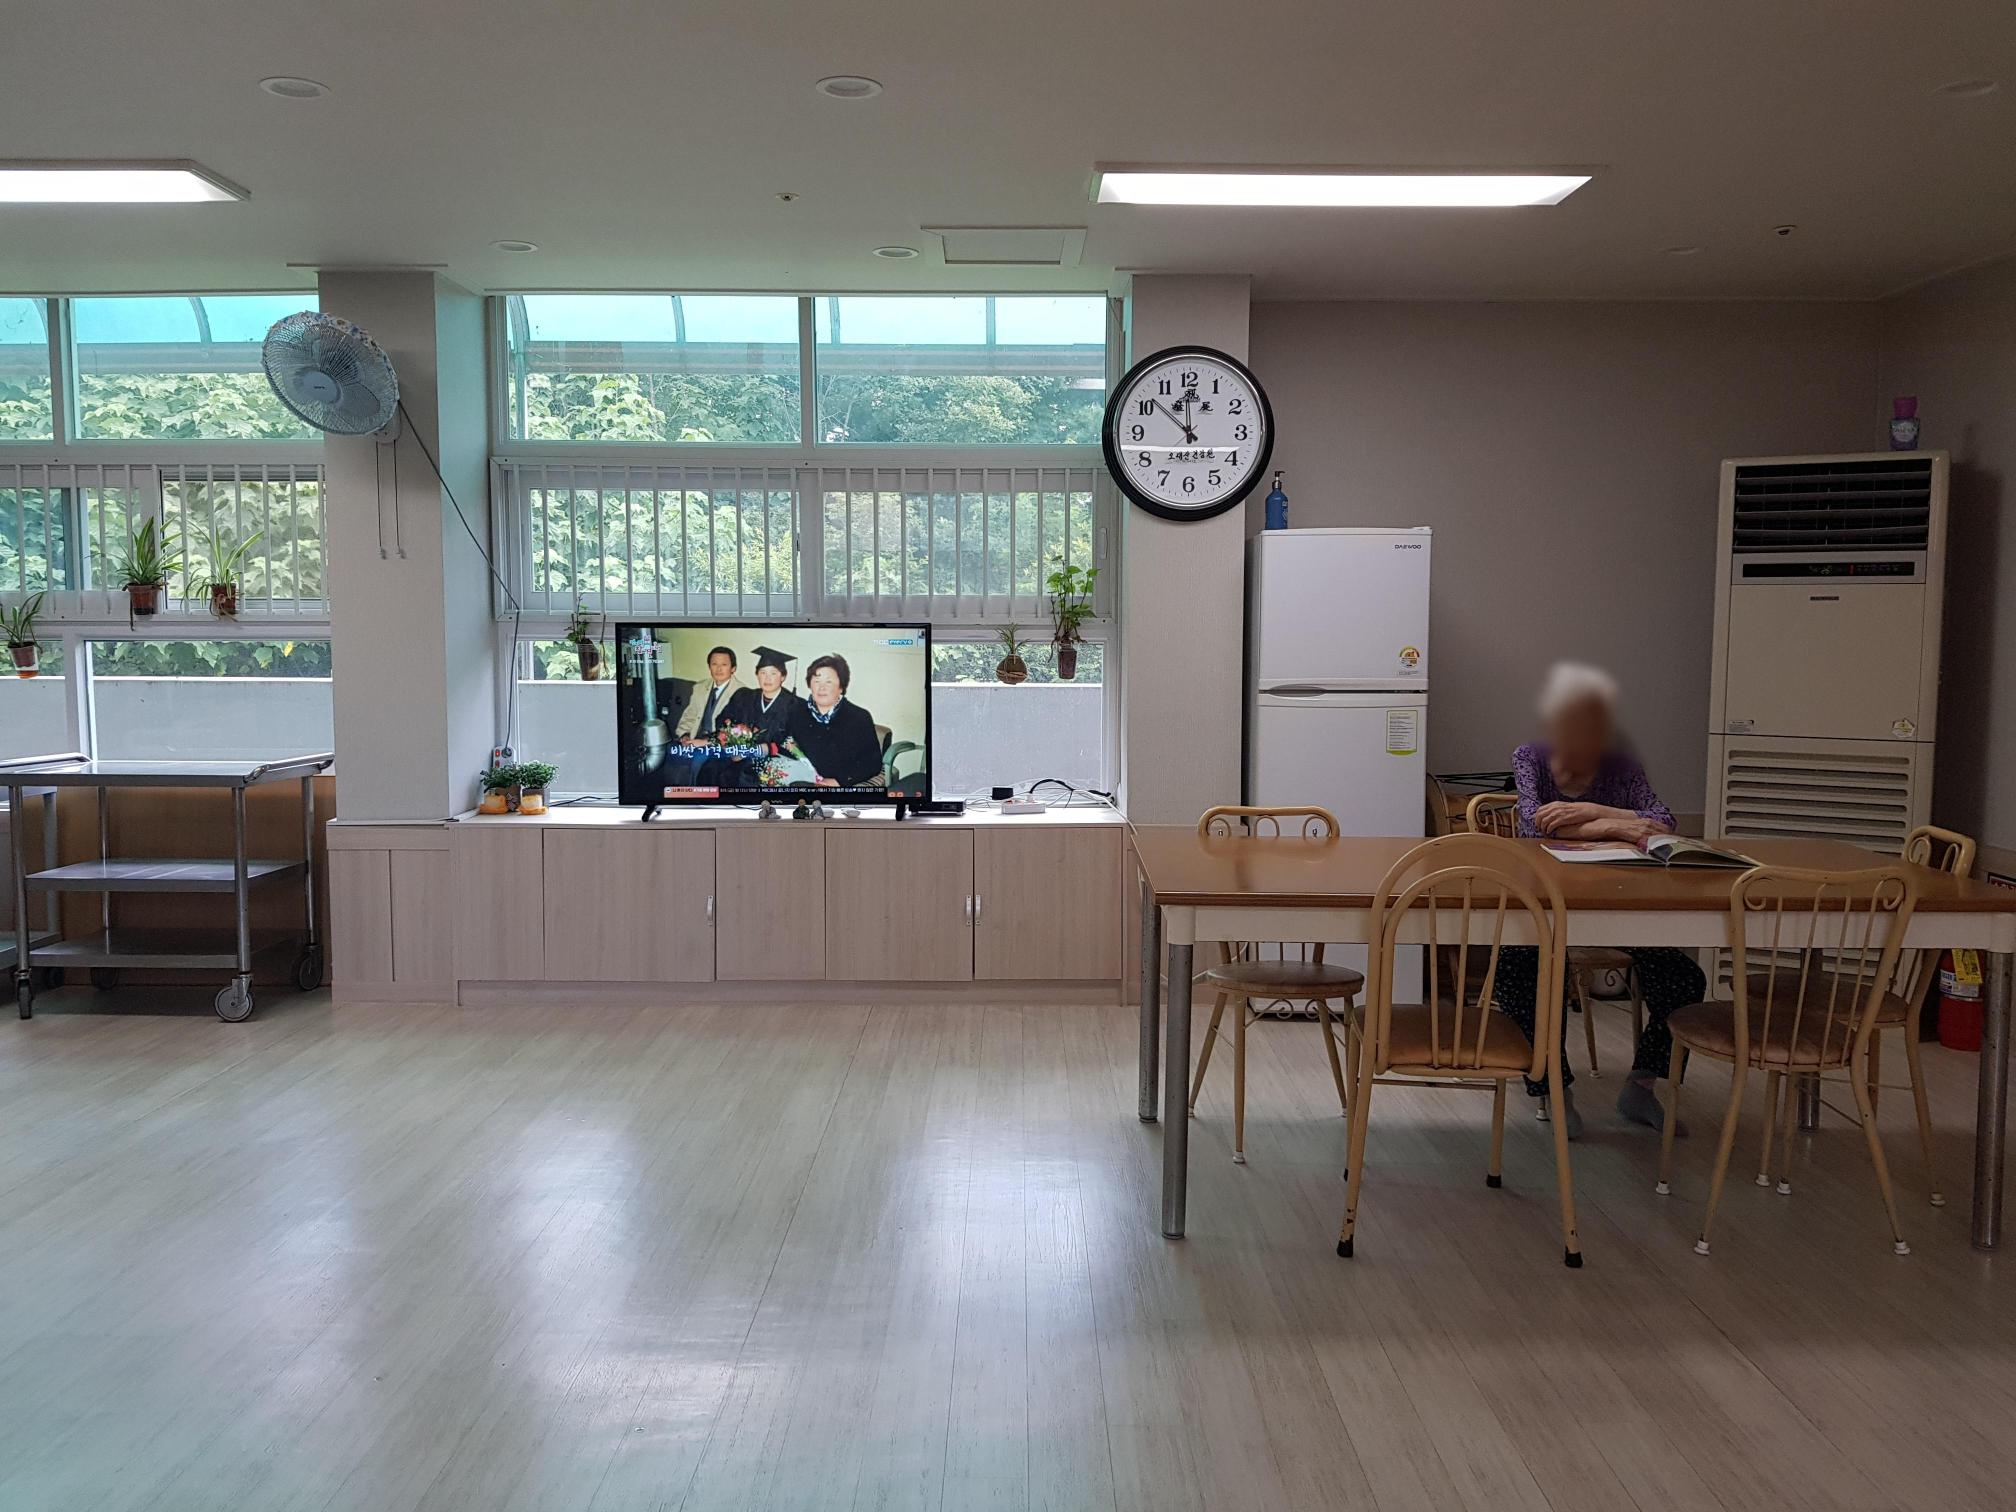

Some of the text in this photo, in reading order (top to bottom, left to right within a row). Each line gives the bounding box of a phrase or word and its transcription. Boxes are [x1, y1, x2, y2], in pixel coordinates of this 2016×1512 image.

[1181, 372, 1199, 387] 12
[1212, 378, 1219, 394] 1
[1159, 380, 1171, 395] 11
[1139, 400, 1153, 415] 10
[1228, 399, 1242, 415] 2
[1132, 425, 1144, 441] 9
[1235, 425, 1247, 440] 3
[1139, 452, 1151, 467] 8
[1225, 451, 1239, 466] 4
[1158, 470, 1170, 486] 7
[1183, 477, 1195, 492] 6
[1208, 469, 1221, 485] 5
[670, 744, 762, 758] 비싼 가격 때문에
